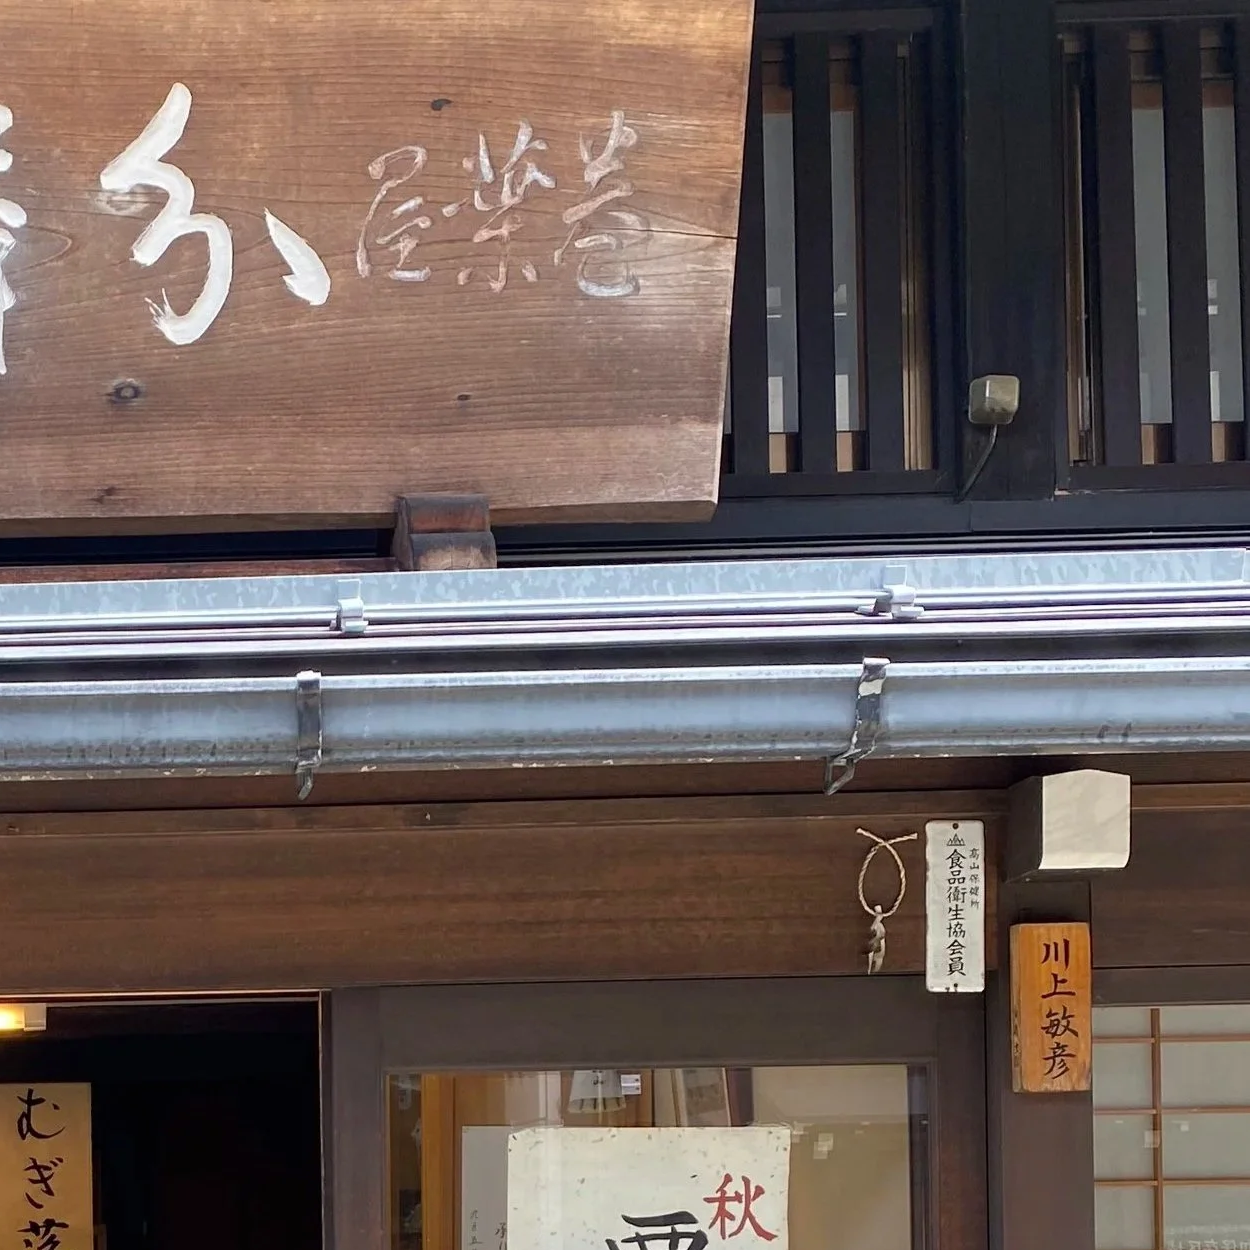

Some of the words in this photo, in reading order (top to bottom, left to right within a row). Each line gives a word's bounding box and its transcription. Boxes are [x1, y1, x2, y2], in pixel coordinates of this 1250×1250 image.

[945, 849, 968, 977] 食品衛生協会員
[968, 847, 981, 910] 高山保健所
[1040, 938, 1079, 1079] 川上敏彦
